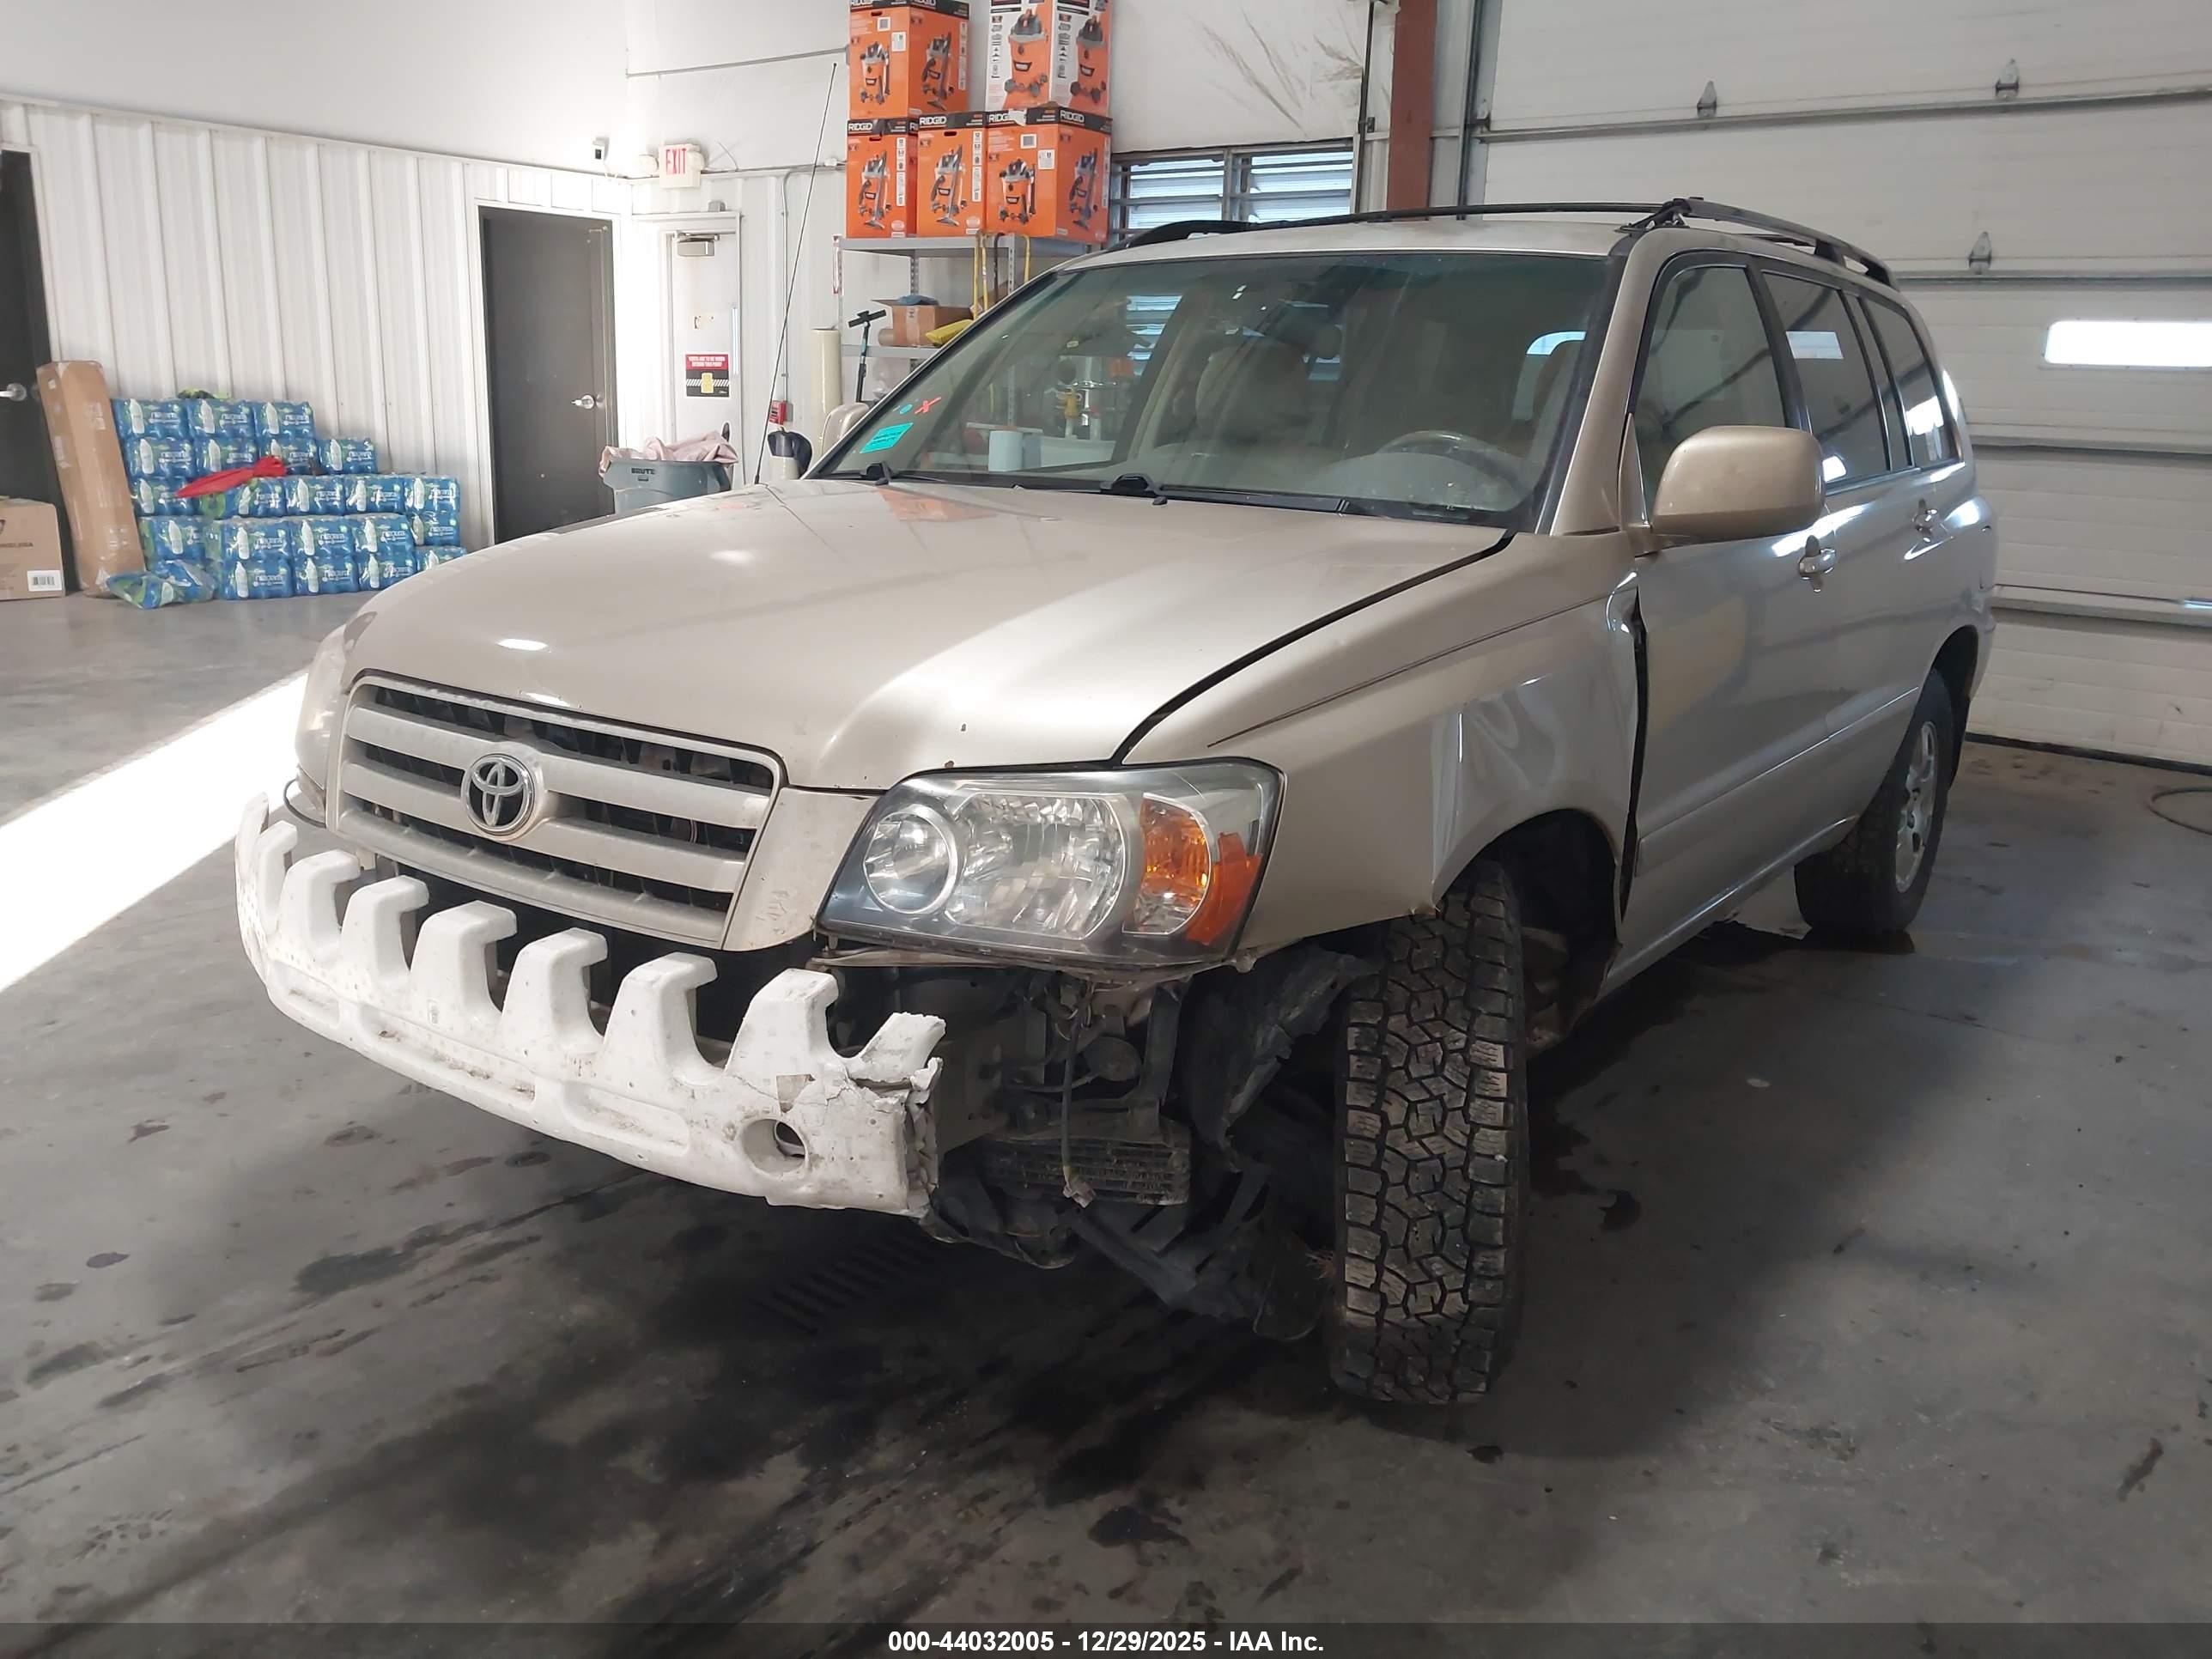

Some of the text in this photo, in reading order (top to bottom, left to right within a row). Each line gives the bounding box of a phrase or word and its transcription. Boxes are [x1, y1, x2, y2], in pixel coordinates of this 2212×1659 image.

[919, 116, 947, 125] RIDGID
[1060, 109, 1085, 123] RIDGID
[848, 122, 873, 131] RIDGID
[665, 148, 687, 175] EXIT
